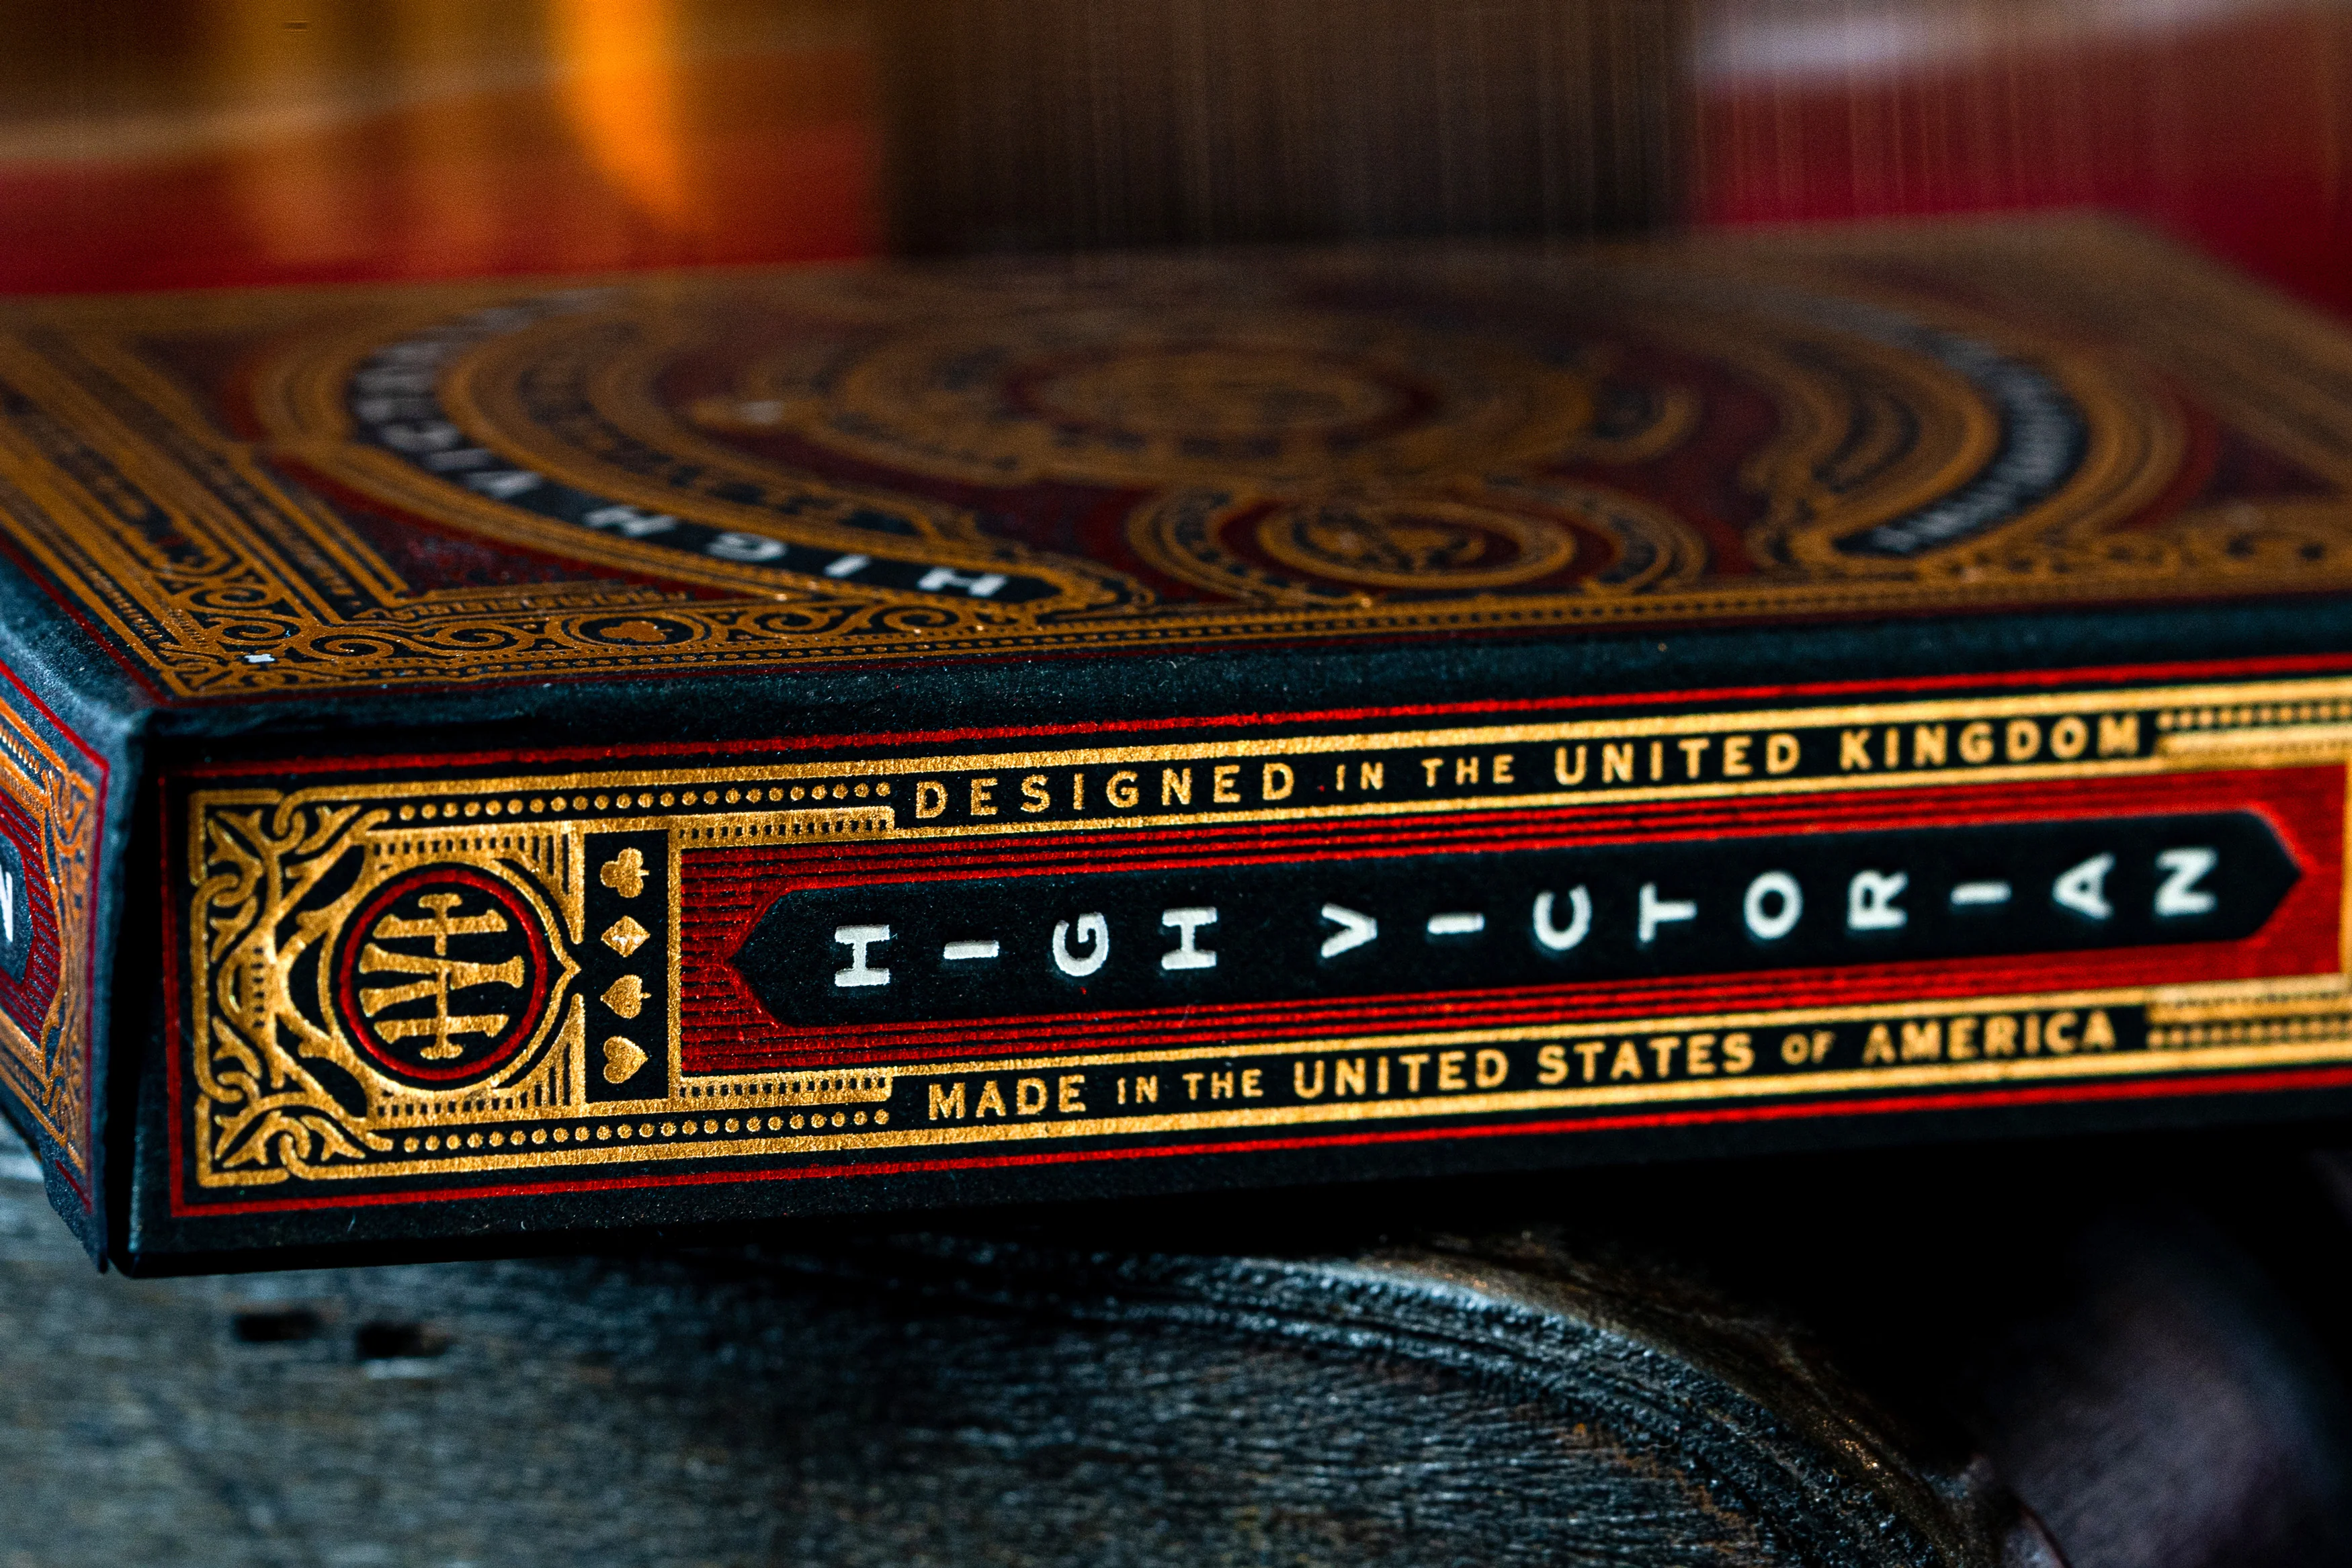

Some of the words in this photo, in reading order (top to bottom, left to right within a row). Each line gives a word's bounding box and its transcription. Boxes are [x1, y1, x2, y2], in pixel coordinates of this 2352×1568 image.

[916, 761, 1296, 819] DESIGNED
[1335, 760, 1384, 791] IN
[1421, 753, 1516, 787] THE
[1554, 732, 1802, 786] UNITED
[1837, 713, 2142, 771] KINGDOM
[835, 907, 1218, 988] HIGH
[1320, 847, 2218, 959] VICTORIAN
[929, 1075, 1086, 1121] MADE
[1117, 1075, 1158, 1105] IN
[1182, 1068, 1264, 1100] THE
[1294, 1049, 1509, 1099] UNITED
[1537, 1033, 1756, 1084] STATES
[1781, 1031, 1837, 1065] OF
[1863, 1010, 2117, 1065] AMERICA
